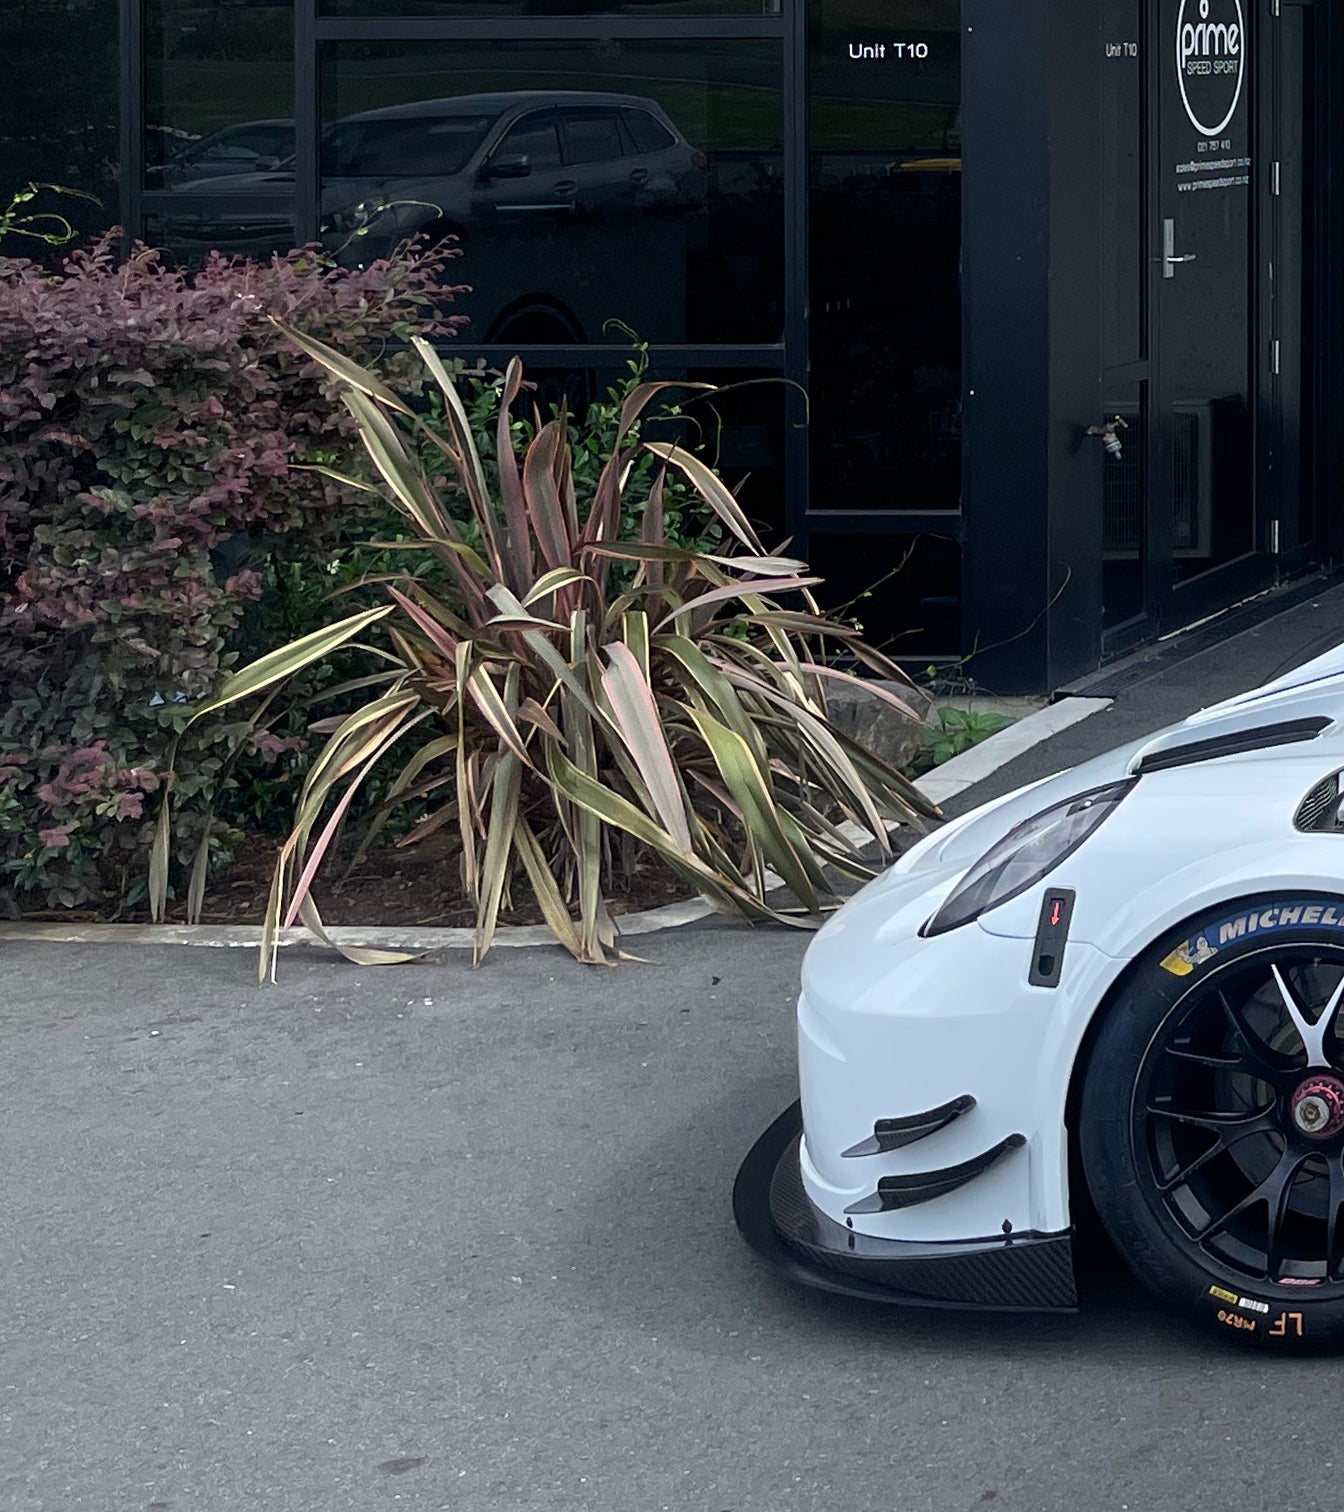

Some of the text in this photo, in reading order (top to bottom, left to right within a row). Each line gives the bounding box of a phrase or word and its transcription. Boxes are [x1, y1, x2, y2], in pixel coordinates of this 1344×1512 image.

[849, 43, 928, 59] Unit T10
[1105, 42, 1138, 57] Unit T10
[1186, 59, 1239, 75] SPEED SPORT
[1268, 1312, 1303, 1336] LF
